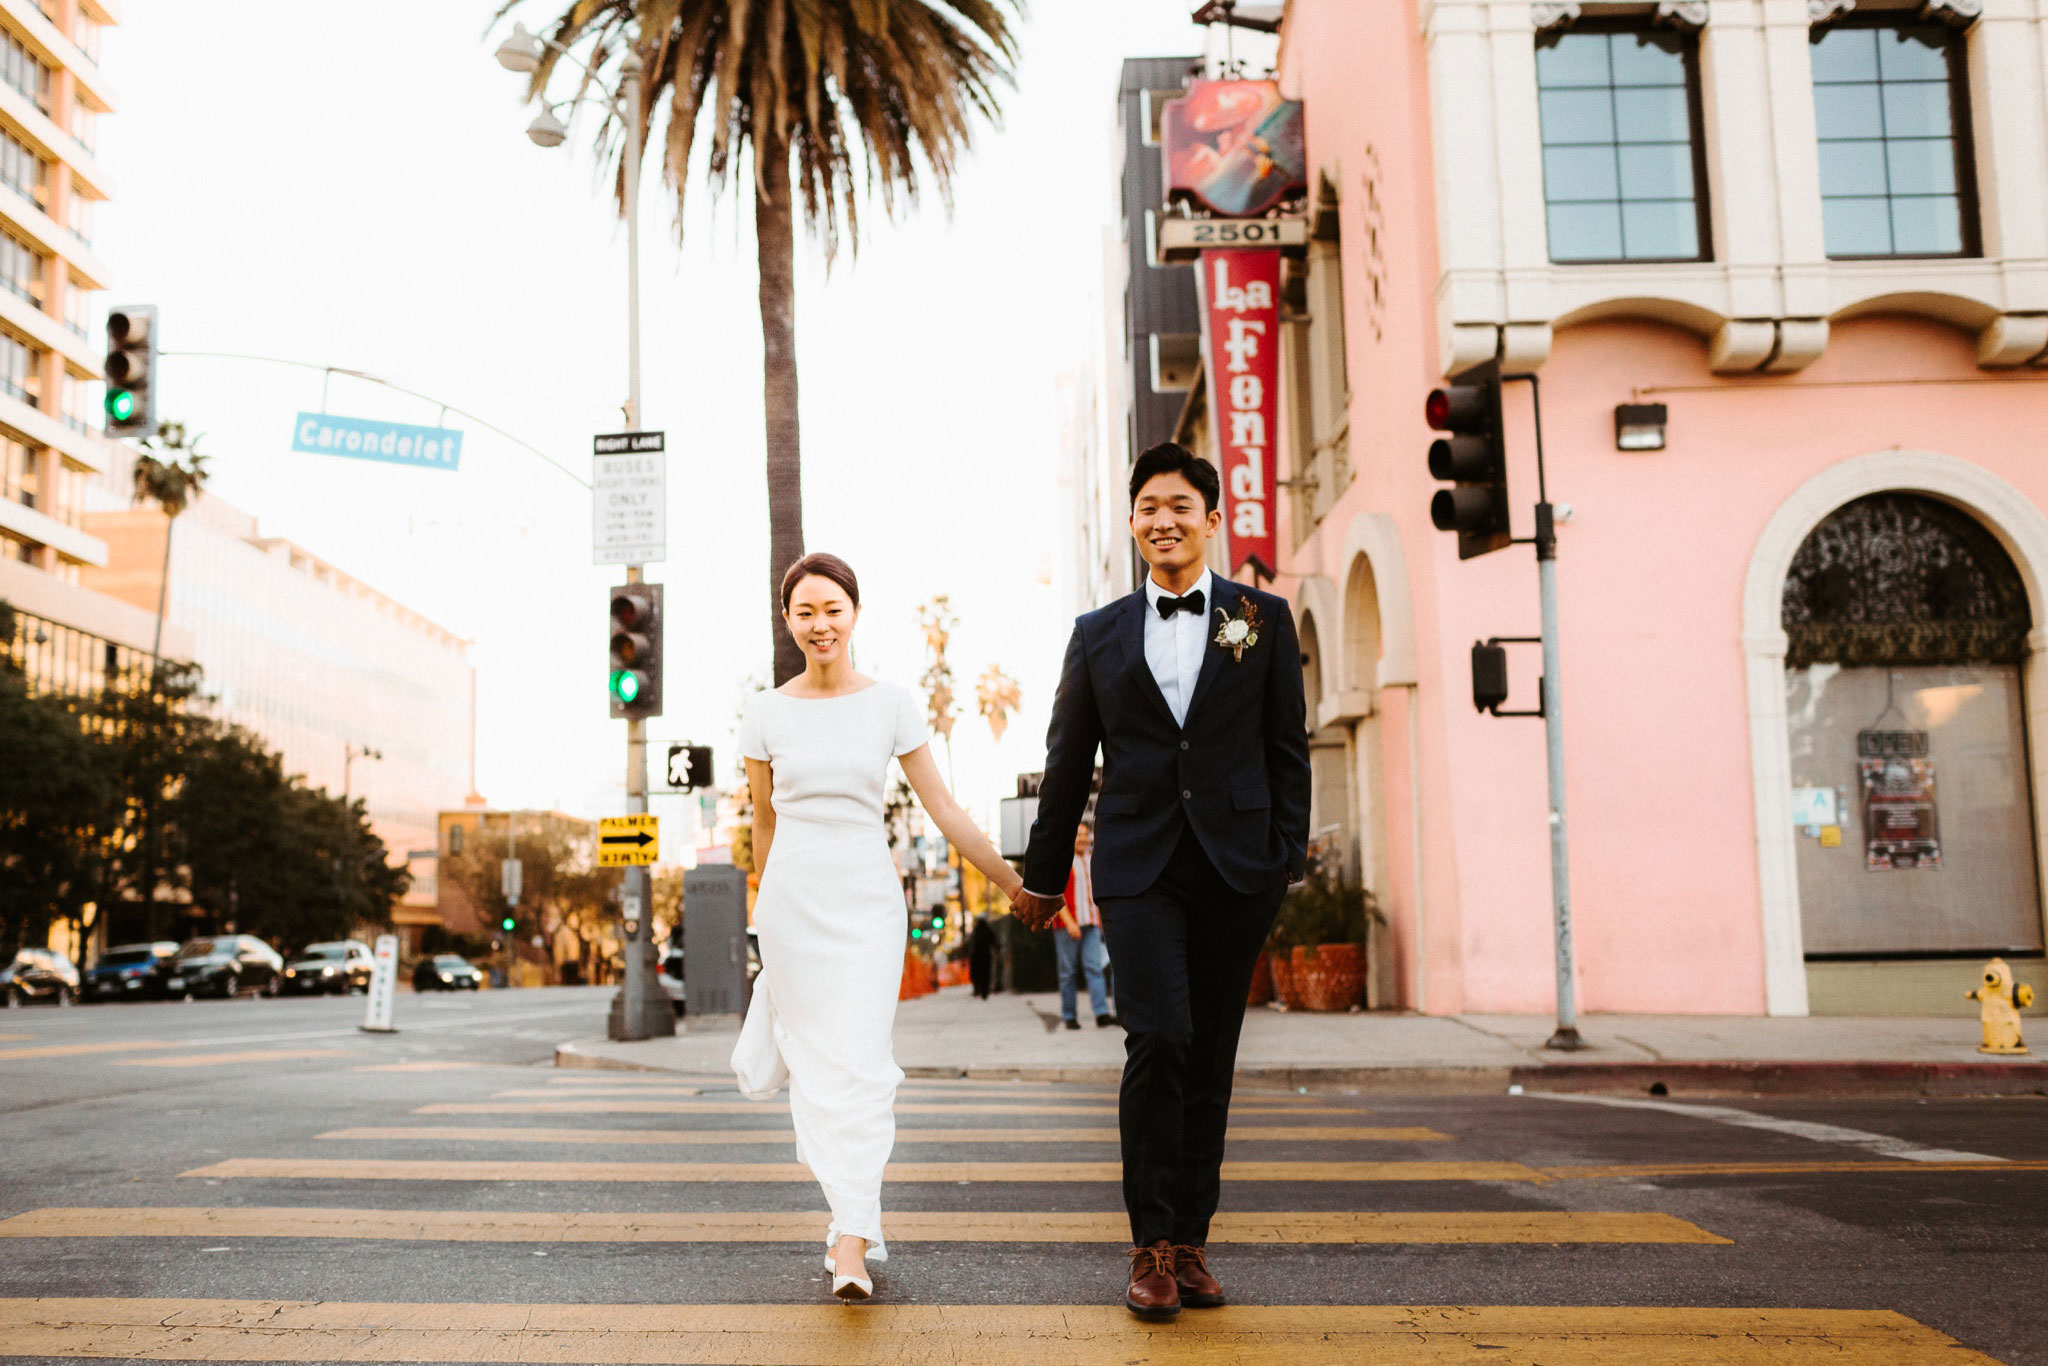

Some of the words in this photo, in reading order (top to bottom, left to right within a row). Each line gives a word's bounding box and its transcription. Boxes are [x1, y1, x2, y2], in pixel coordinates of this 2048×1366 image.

[1194, 223, 1280, 242] 2501
[1213, 257, 1273, 313] La
[1224, 317, 1268, 538] Fonda
[300, 419, 455, 463] Carondelet
[595, 438, 629, 452] RIGHT
[632, 435, 663, 450] LANE
[608, 491, 648, 507] ONLY
[601, 816, 657, 827] PALMER
[601, 852, 658, 865] PALMER
